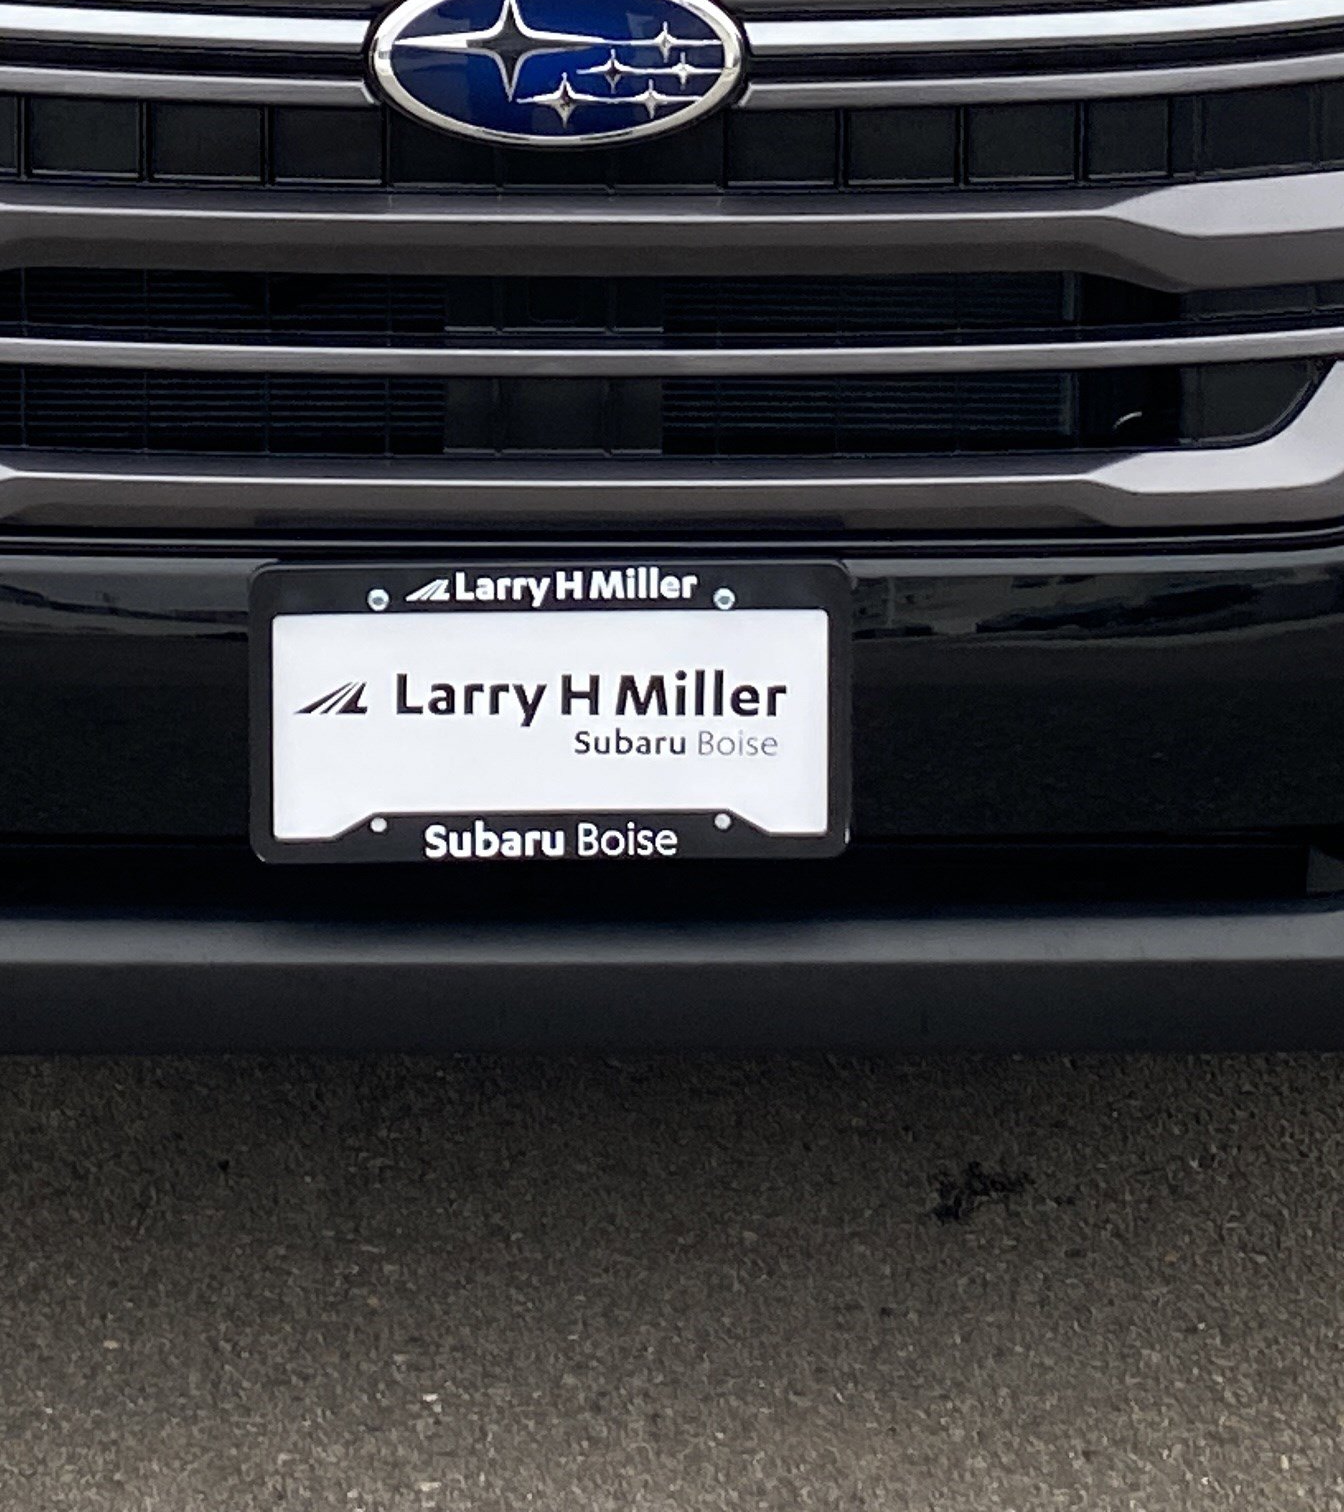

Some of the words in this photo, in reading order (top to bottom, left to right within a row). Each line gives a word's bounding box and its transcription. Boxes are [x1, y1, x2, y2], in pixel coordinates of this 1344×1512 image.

[455, 572, 551, 607] Larry
[555, 571, 583, 601] H
[589, 567, 698, 601] Miller
[396, 673, 548, 727] Larry
[560, 674, 600, 716] H
[615, 669, 787, 717] Miller
[574, 728, 686, 756] Subaru
[698, 731, 778, 756] Boise
[424, 820, 565, 858] Subaru
[577, 821, 678, 857] Boise
